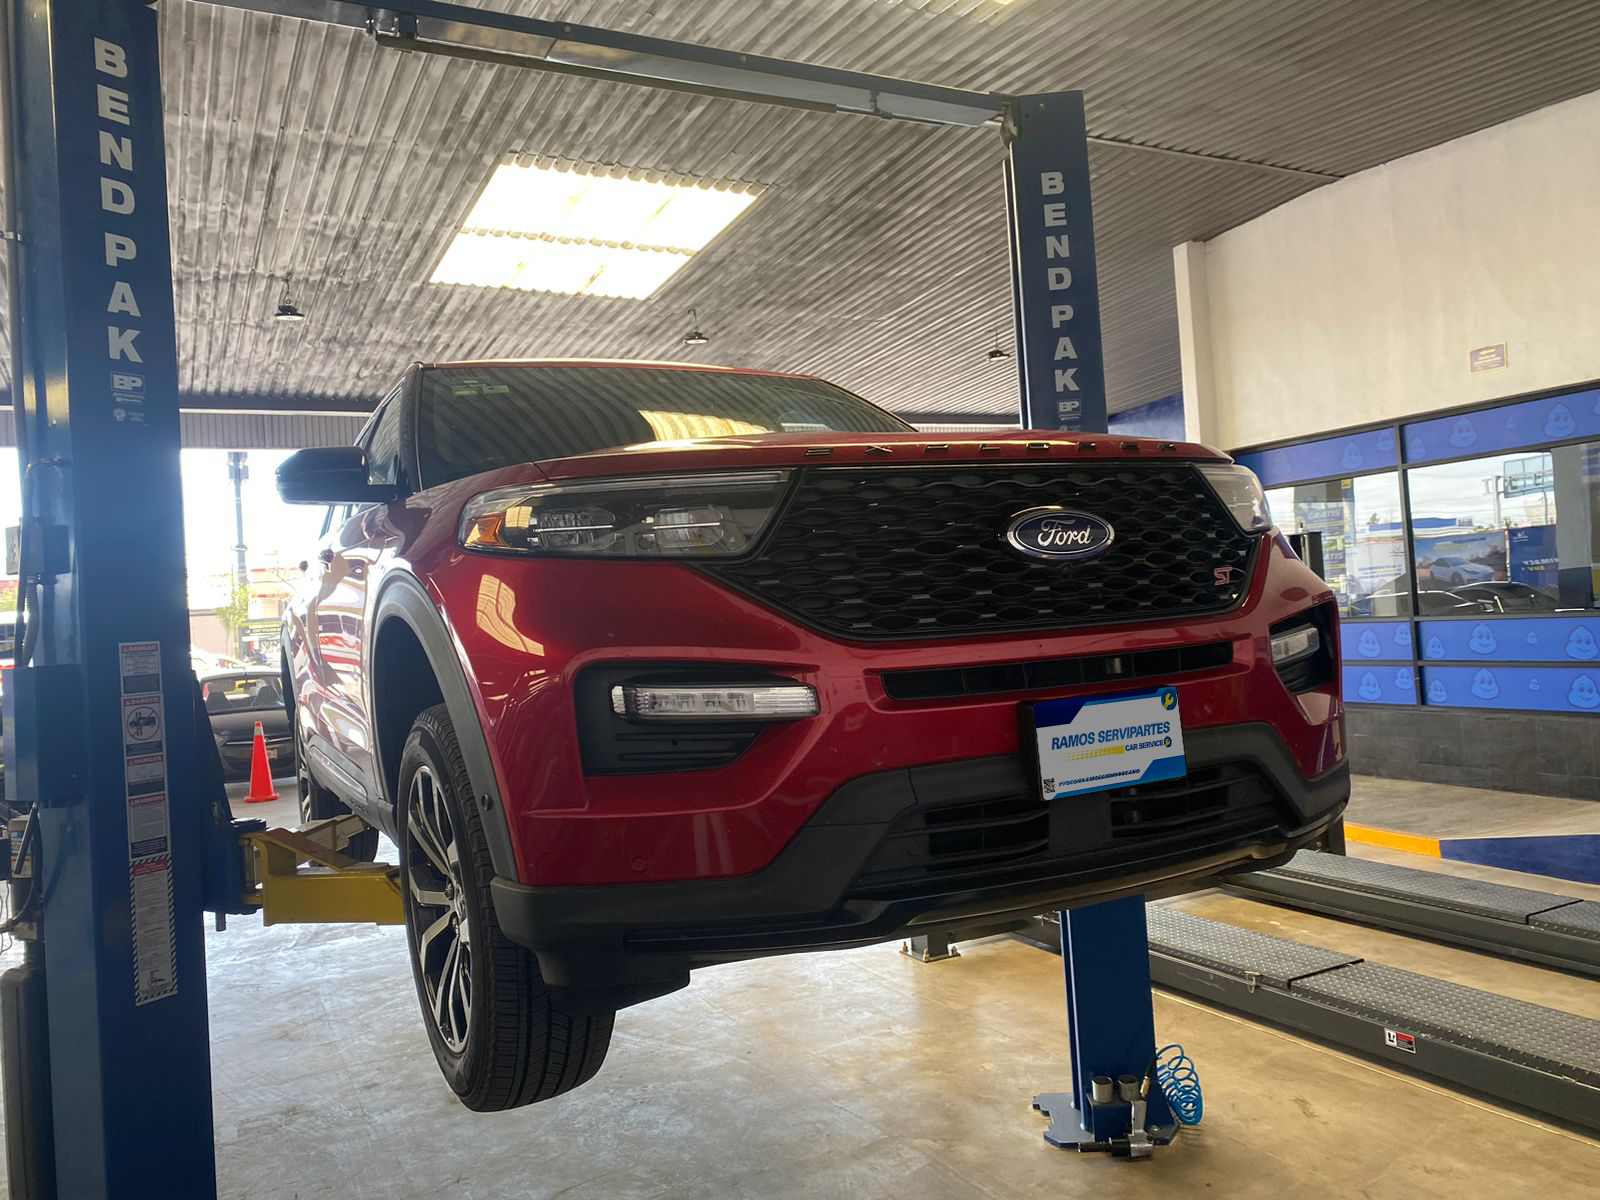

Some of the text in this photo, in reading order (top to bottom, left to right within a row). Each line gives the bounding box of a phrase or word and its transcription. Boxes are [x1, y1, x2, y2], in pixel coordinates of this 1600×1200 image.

[93, 36, 143, 364] BENDPAK
[1040, 171, 1080, 393] BENDPAK
[113, 374, 143, 391] BP
[1037, 519, 1093, 547] Ford
[1213, 566, 1233, 586] ST
[1051, 721, 1171, 751] RAMOS SERVIPARTES
[1125, 739, 1164, 752] CAR SERVICE
